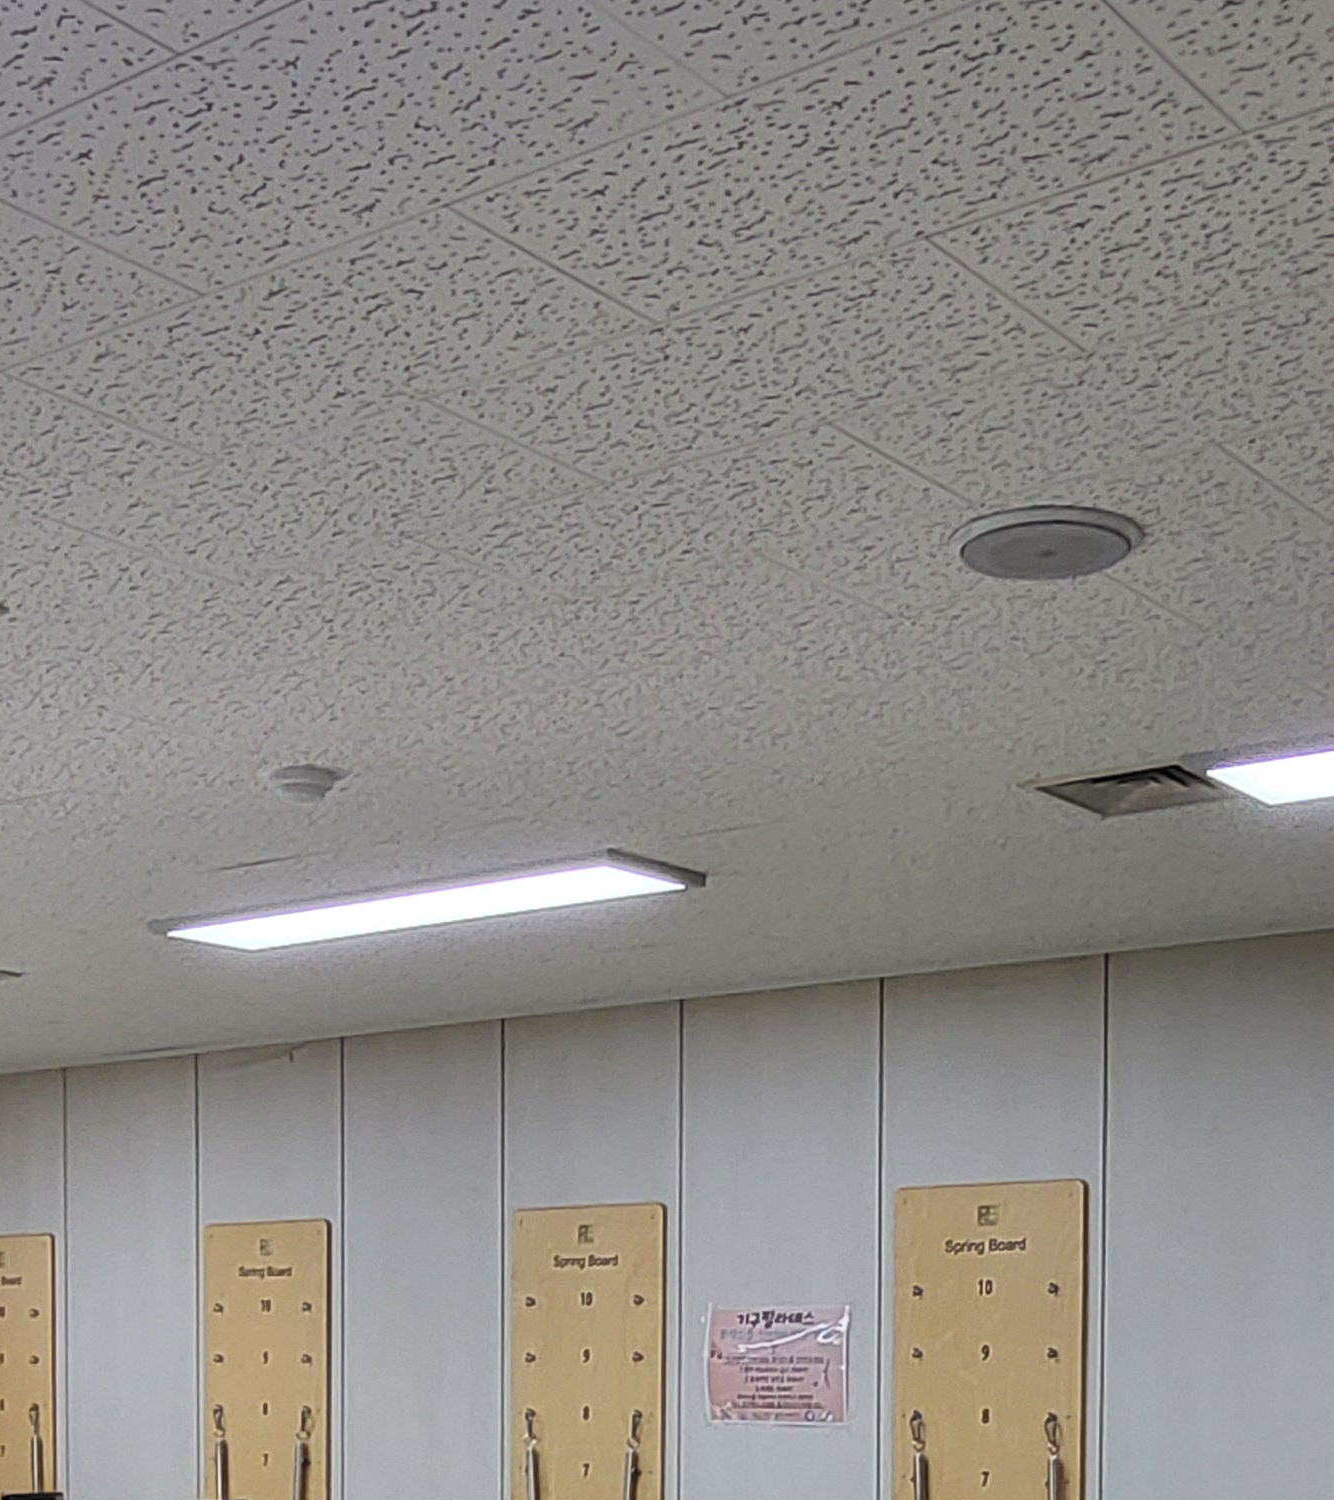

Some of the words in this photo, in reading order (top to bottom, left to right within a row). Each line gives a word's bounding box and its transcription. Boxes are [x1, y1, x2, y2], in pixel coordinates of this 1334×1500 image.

[944, 1238, 985, 1256] Spring
[988, 1236, 1027, 1253] Board
[978, 1278, 993, 1297] 10
[980, 1344, 990, 1362] 9
[980, 1470, 990, 1488] 7
